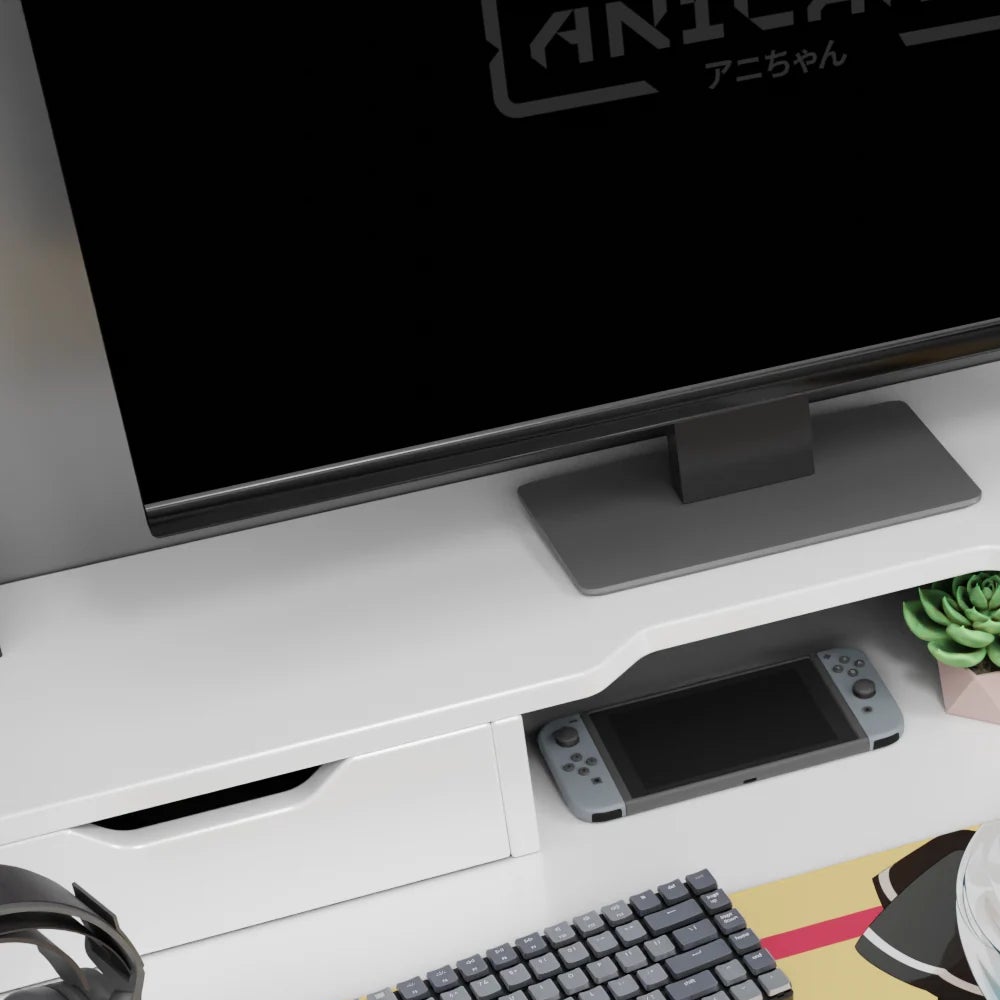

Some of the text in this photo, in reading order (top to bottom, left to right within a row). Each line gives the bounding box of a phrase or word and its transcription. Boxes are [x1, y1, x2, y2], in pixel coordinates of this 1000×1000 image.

[705, 40, 848, 90] アニちゃん
